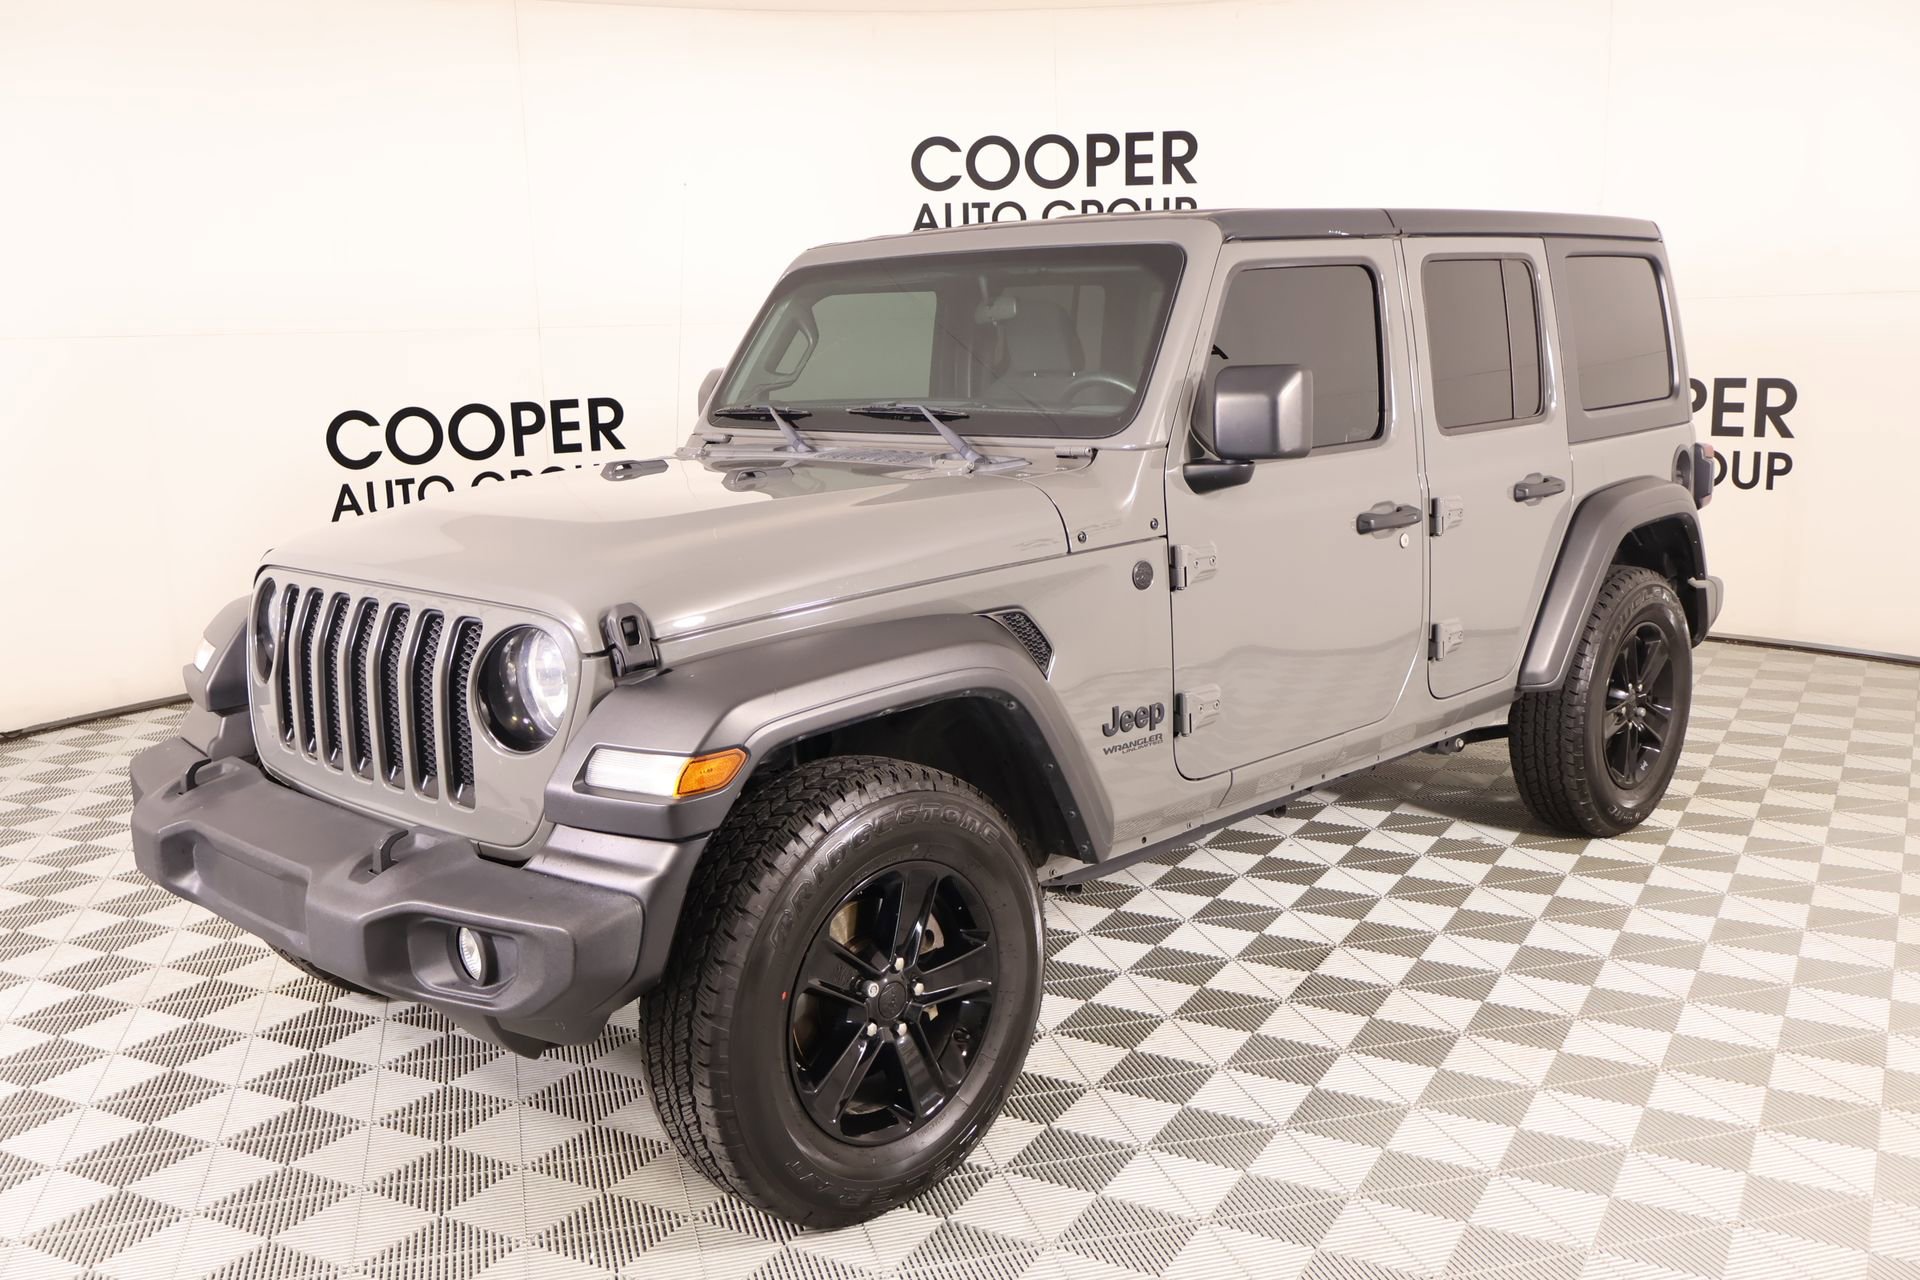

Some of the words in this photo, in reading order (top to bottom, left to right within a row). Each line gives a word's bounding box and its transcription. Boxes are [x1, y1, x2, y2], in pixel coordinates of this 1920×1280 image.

[911, 130, 1198, 192] COOPER
[913, 201, 1026, 232] AUTO
[326, 397, 626, 470] COOPER
[331, 475, 455, 522] AUTO
[1102, 702, 1165, 737] Jeep
[1103, 733, 1163, 755] WRANGLER
